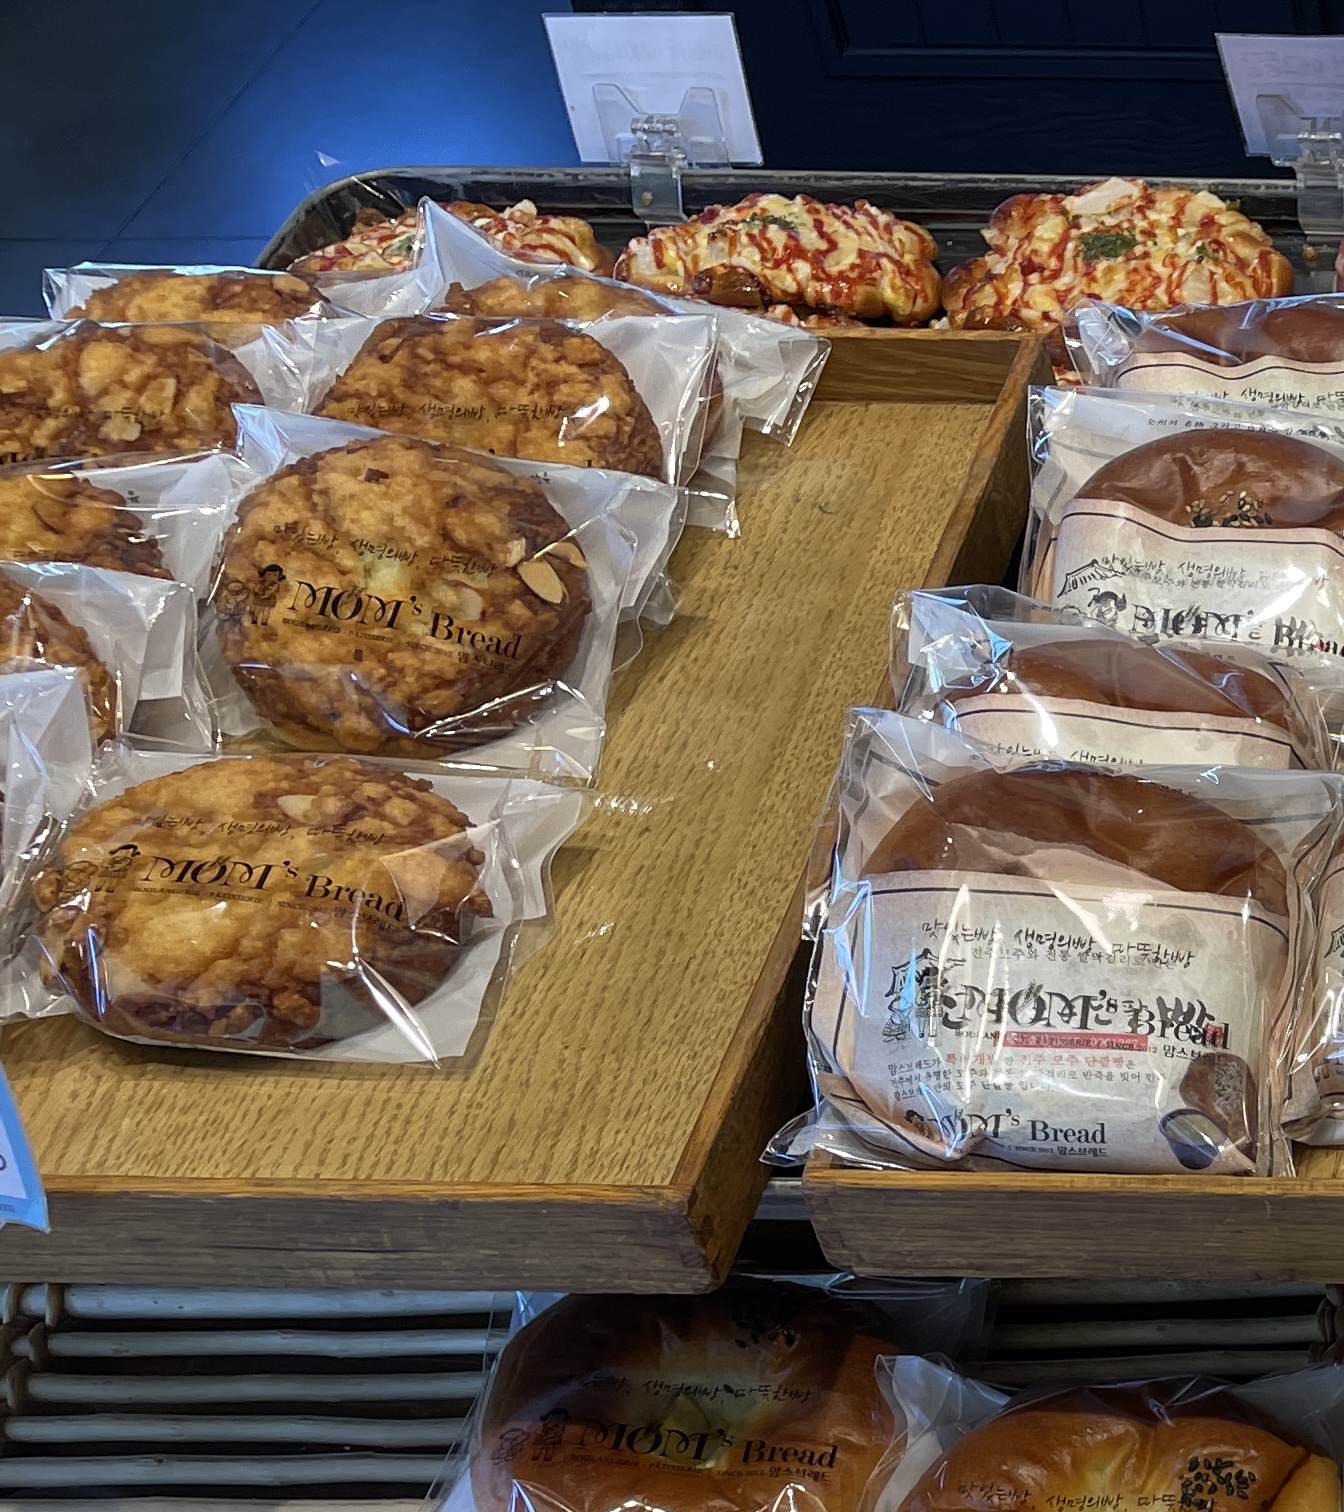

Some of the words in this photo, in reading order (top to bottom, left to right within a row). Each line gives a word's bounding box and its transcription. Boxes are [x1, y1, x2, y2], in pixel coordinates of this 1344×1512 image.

[287, 580, 423, 630] MOM's
[431, 610, 522, 660] Bread
[1028, 1119, 1108, 1145] Bread
[741, 1438, 838, 1468] Bread
